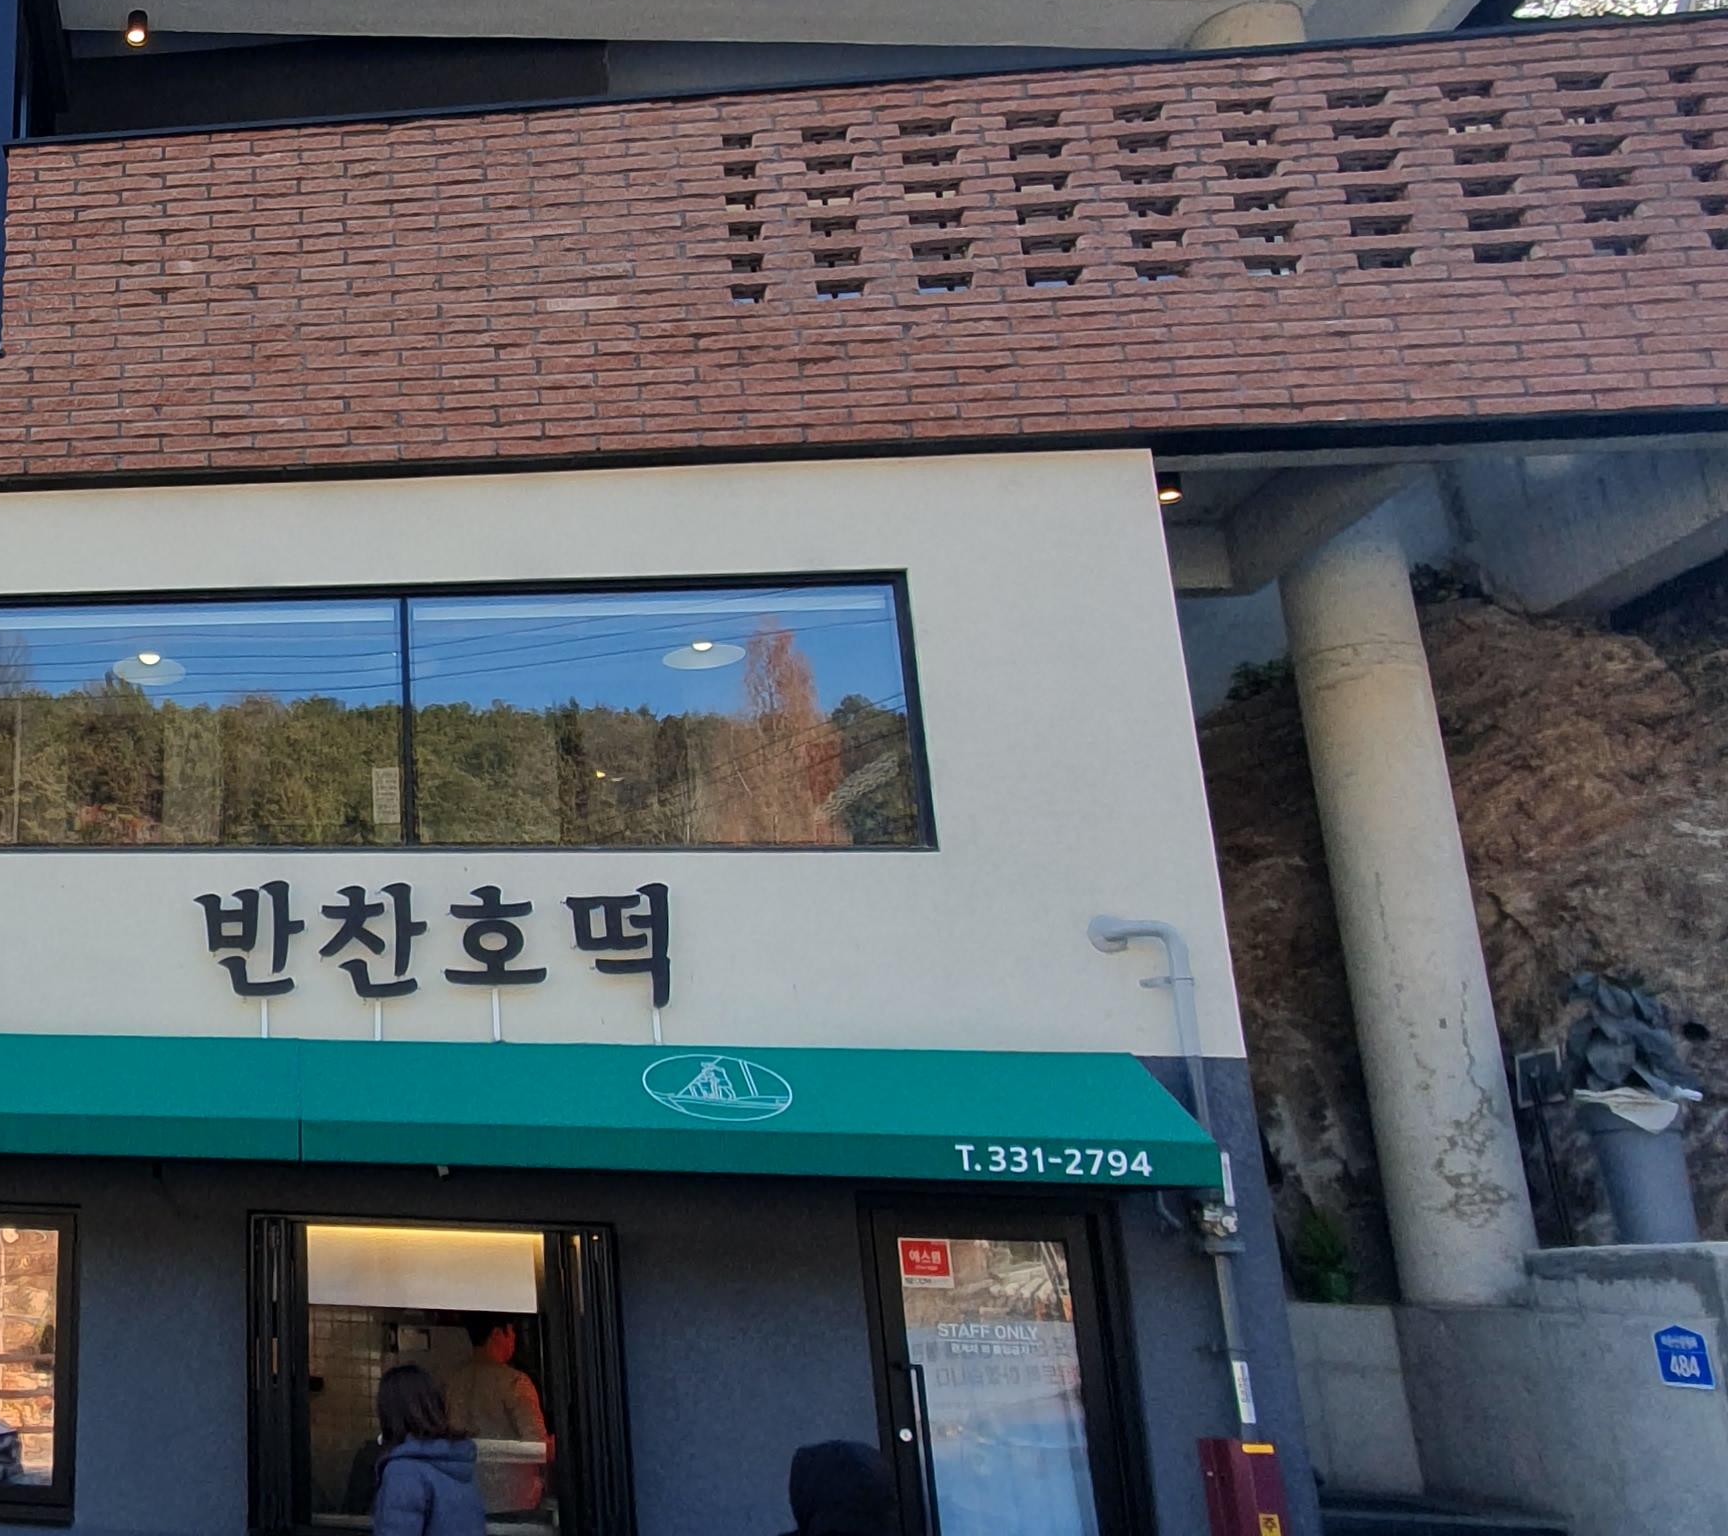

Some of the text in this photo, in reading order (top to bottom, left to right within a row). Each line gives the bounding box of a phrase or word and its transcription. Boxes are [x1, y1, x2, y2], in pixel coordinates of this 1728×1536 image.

[193, 880, 671, 1008] 반찬호떡
[955, 1143, 1153, 1178] T.331-2794
[937, 1323, 1039, 1341] STAFF ONLY
[1670, 1354, 1701, 1378] 484
